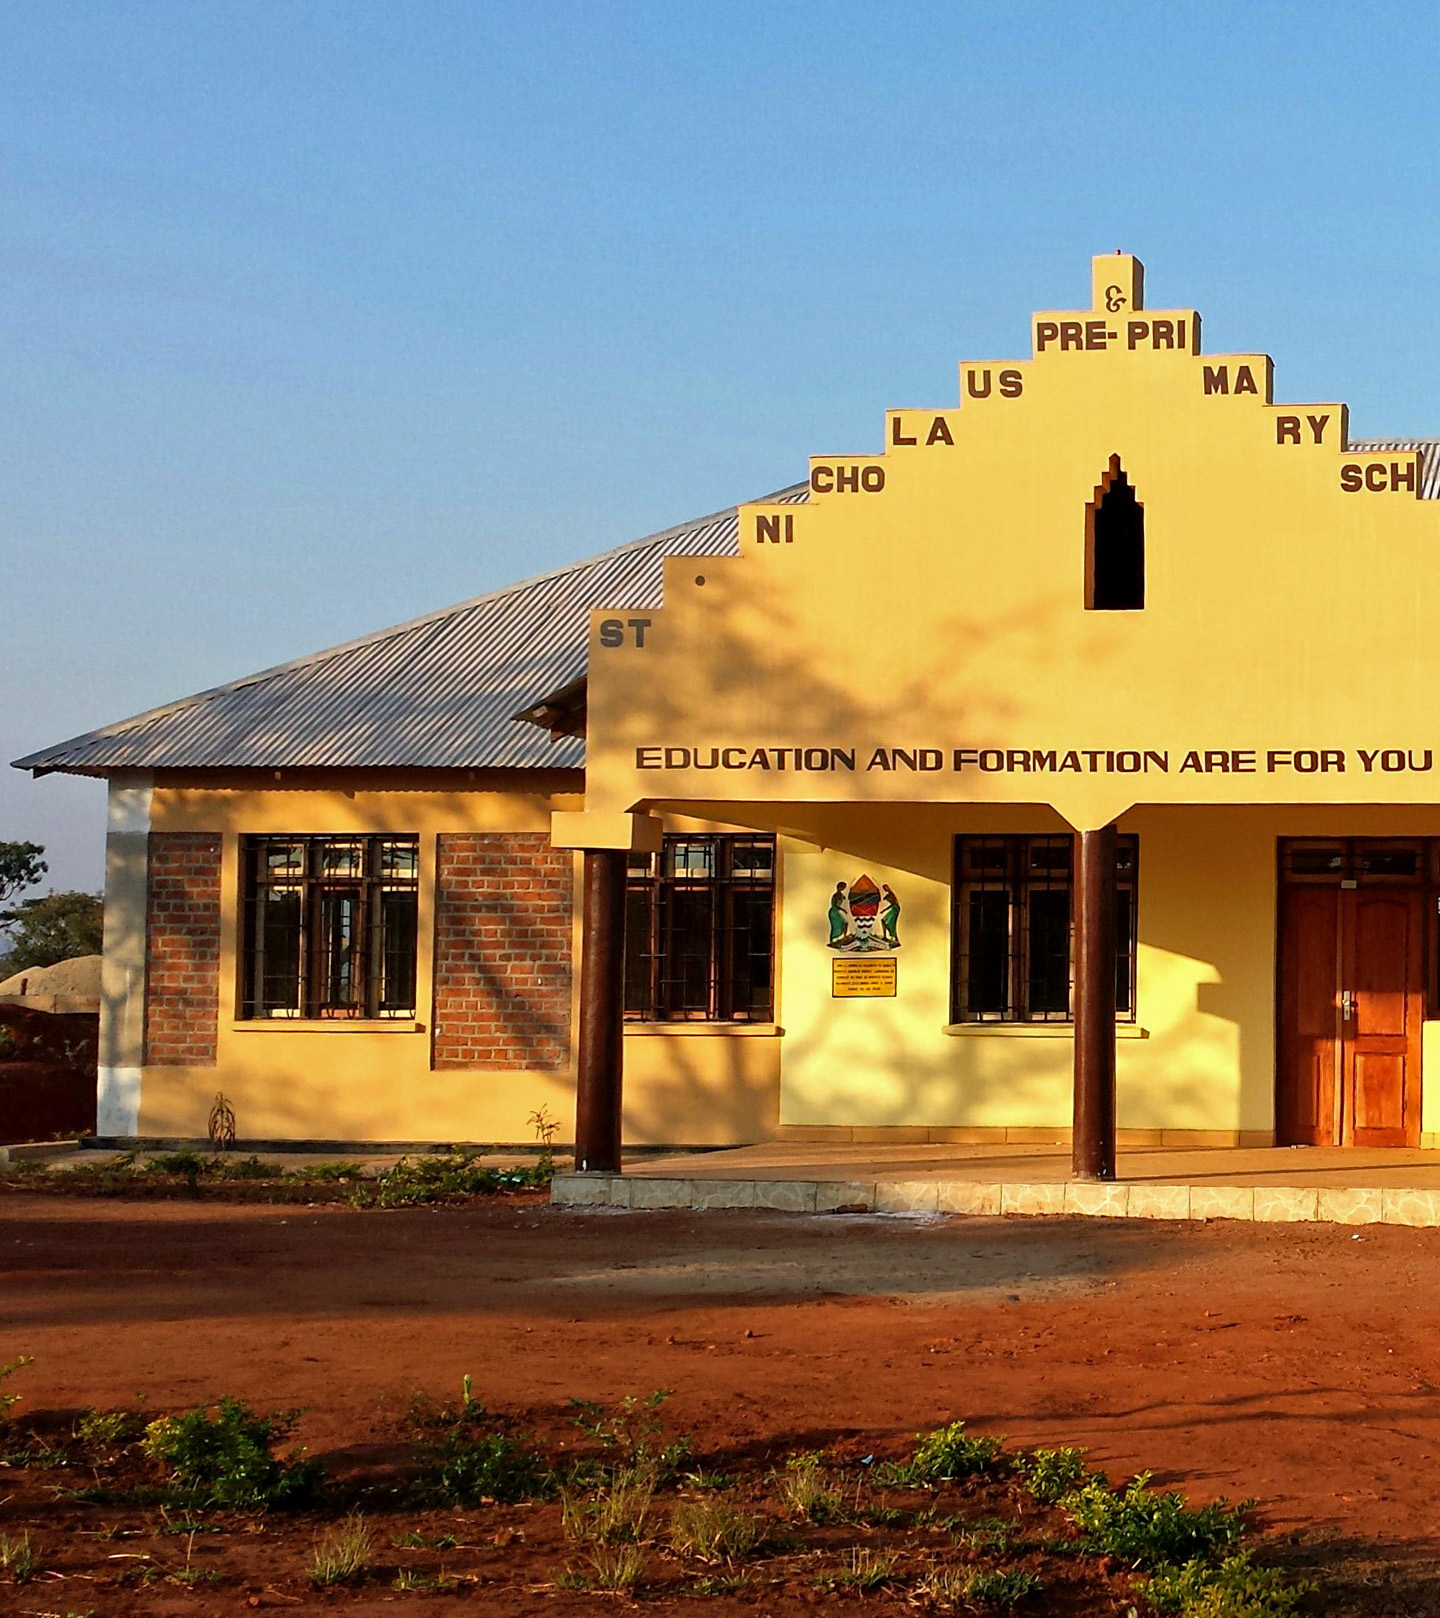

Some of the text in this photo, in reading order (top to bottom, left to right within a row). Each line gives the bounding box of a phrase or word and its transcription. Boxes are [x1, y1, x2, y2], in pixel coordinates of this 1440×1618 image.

[967, 369, 1024, 399] US
[1203, 365, 1259, 395] MA
[892, 416, 956, 446] LA
[1276, 414, 1331, 445] RY
[811, 465, 886, 494] CHO
[1340, 462, 1415, 493] SCH
[756, 514, 795, 544] NI
[599, 618, 652, 648] ST
[635, 747, 856, 772] EDUCATION
[865, 747, 943, 772] AND
[953, 749, 1169, 773] FORMATION
[1178, 750, 1257, 774] ARE
[1266, 750, 1346, 773] FOR
[1356, 749, 1433, 773] YOU
